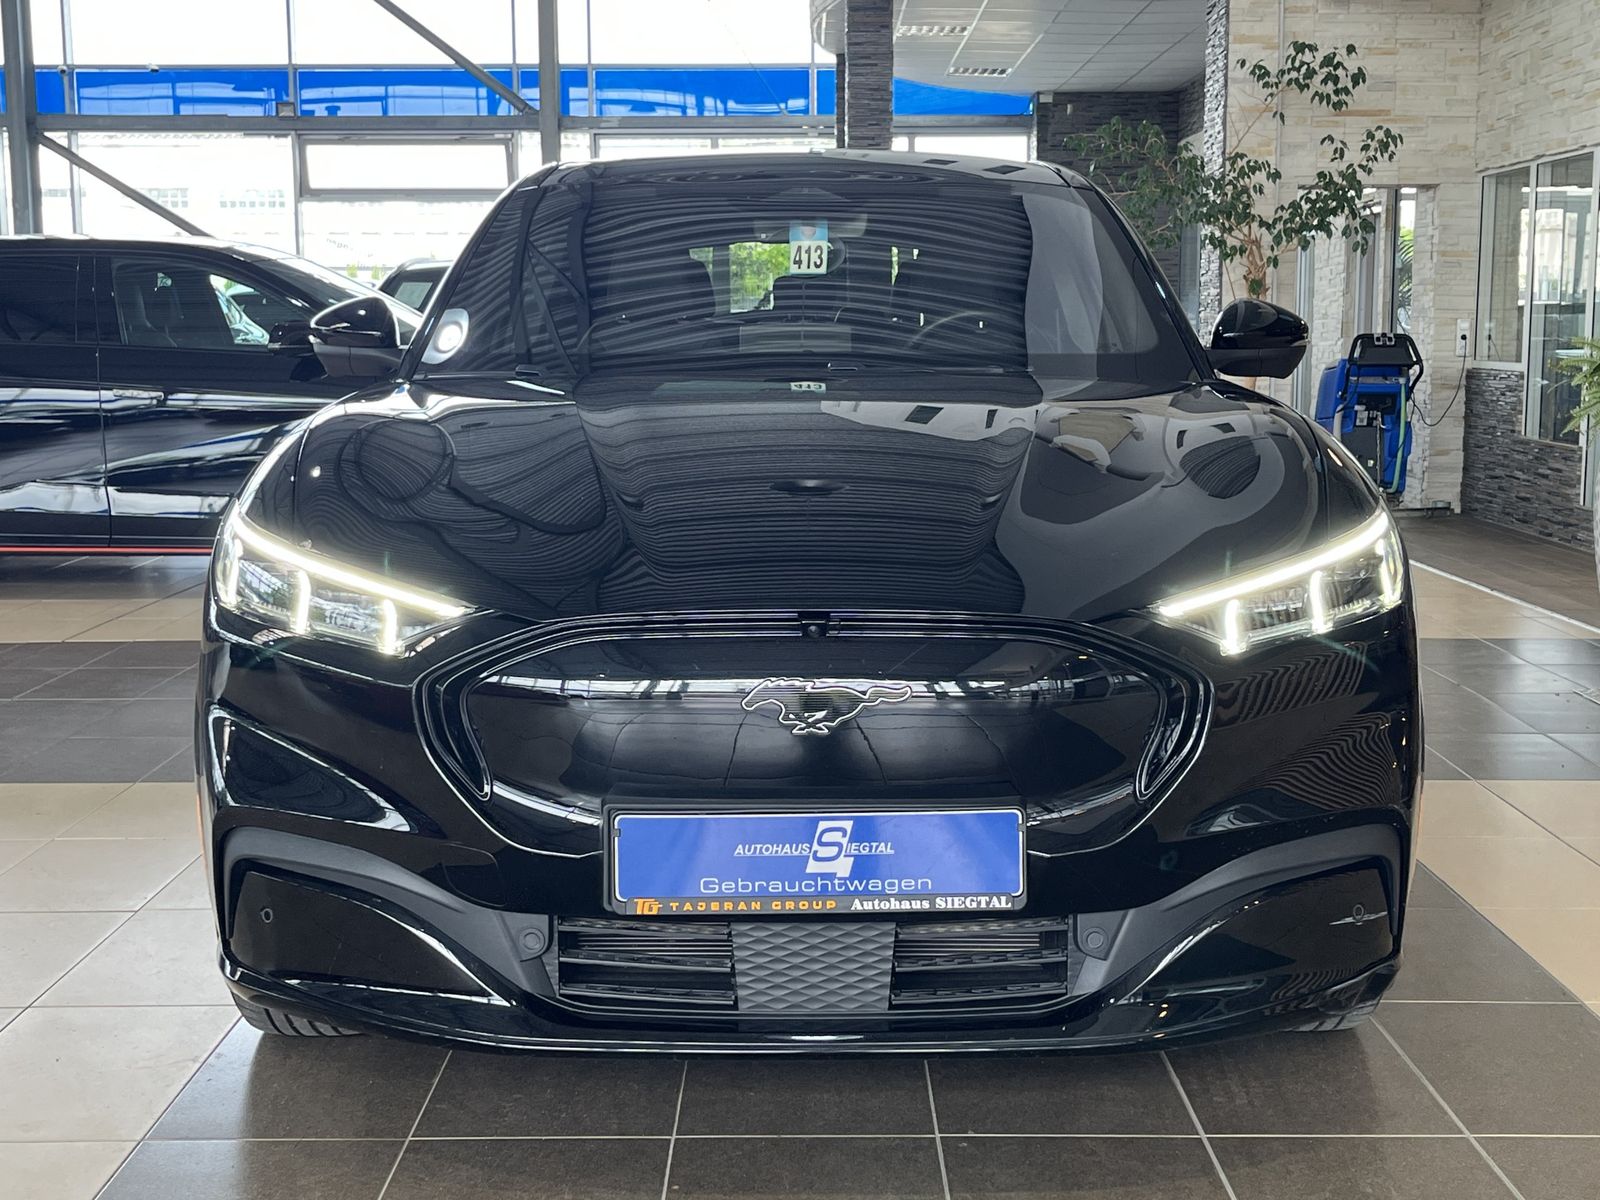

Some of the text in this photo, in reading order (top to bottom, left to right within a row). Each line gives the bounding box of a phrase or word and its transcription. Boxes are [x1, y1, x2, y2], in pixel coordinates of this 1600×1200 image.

[793, 245, 824, 270] 413
[734, 843, 811, 855] AUTOHAUS
[700, 876, 932, 894] Gebrauchtwagen
[771, 900, 837, 910] GROUP
[850, 897, 930, 911] Autohaus
[935, 895, 1012, 910] SIEGTAL
